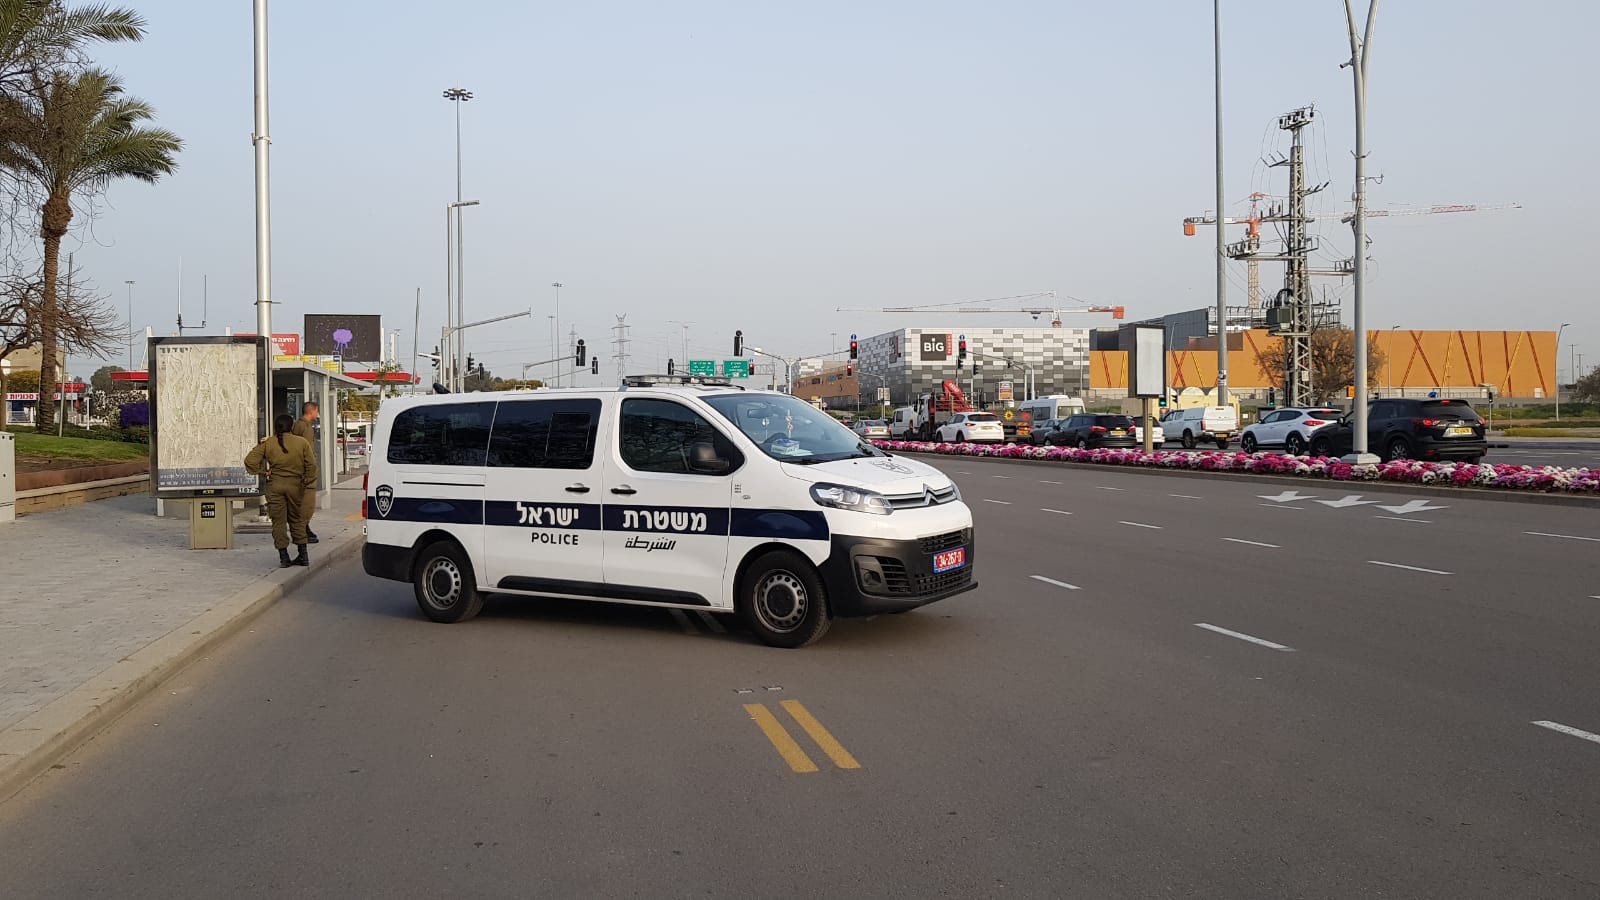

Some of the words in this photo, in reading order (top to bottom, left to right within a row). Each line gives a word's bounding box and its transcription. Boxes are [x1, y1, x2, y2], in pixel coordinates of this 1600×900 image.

[516, 501, 580, 526] ישראל
[622, 509, 707, 532] משטרת
[531, 532, 579, 546] POLICE
[624, 535, 677, 552] الشرطة
